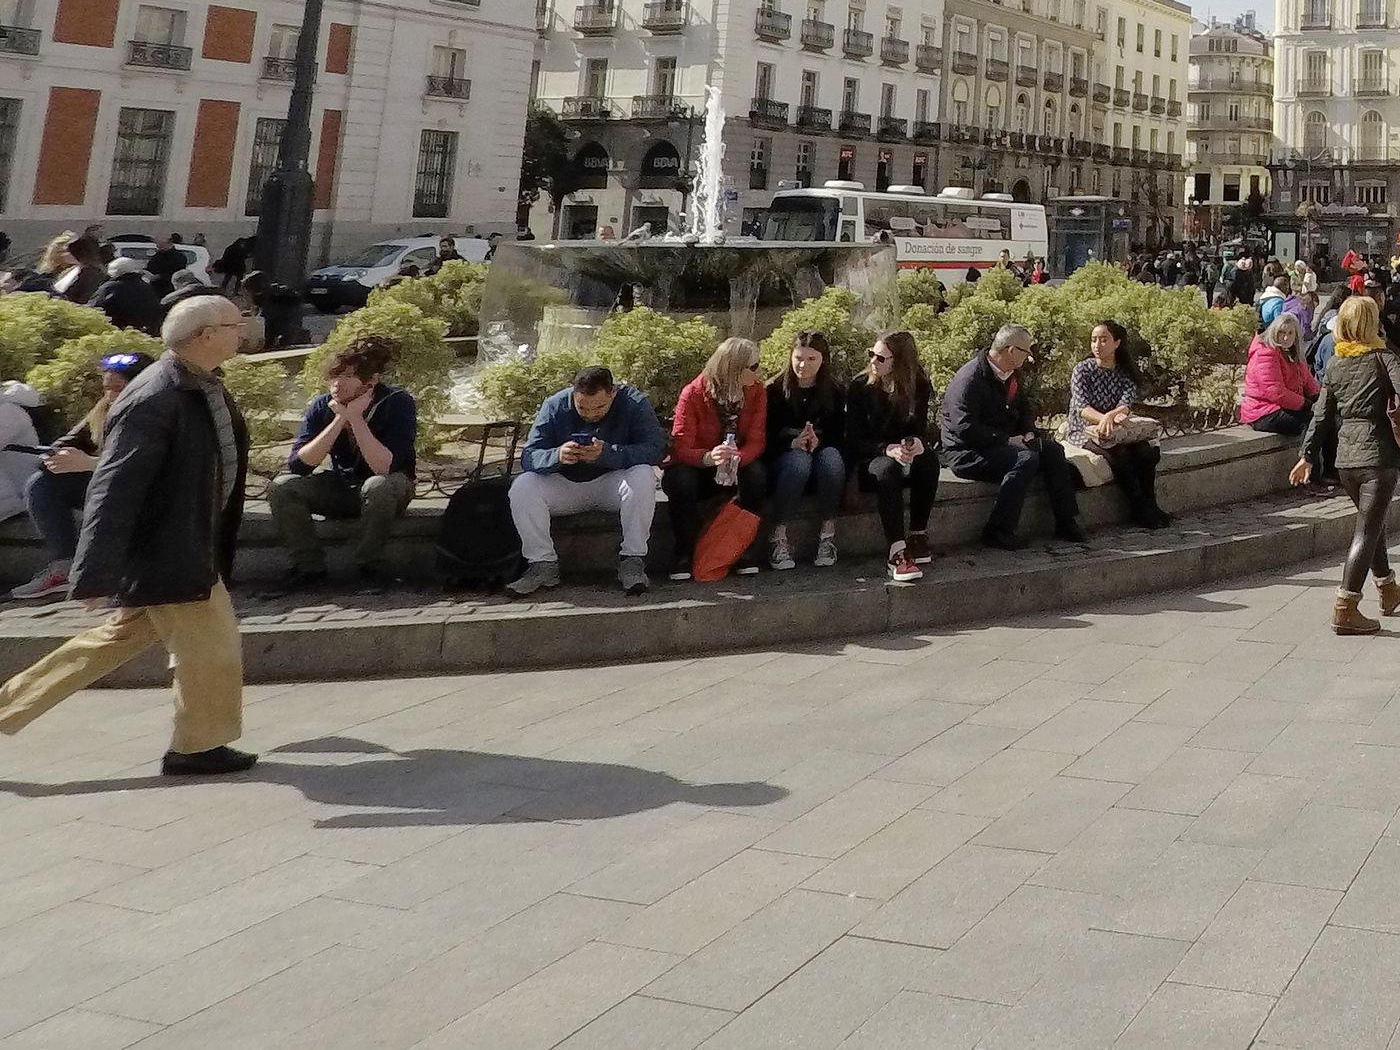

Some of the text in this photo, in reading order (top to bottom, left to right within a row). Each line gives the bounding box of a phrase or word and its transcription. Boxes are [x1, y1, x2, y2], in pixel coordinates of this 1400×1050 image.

[904, 241, 983, 258] Donación de sangre
